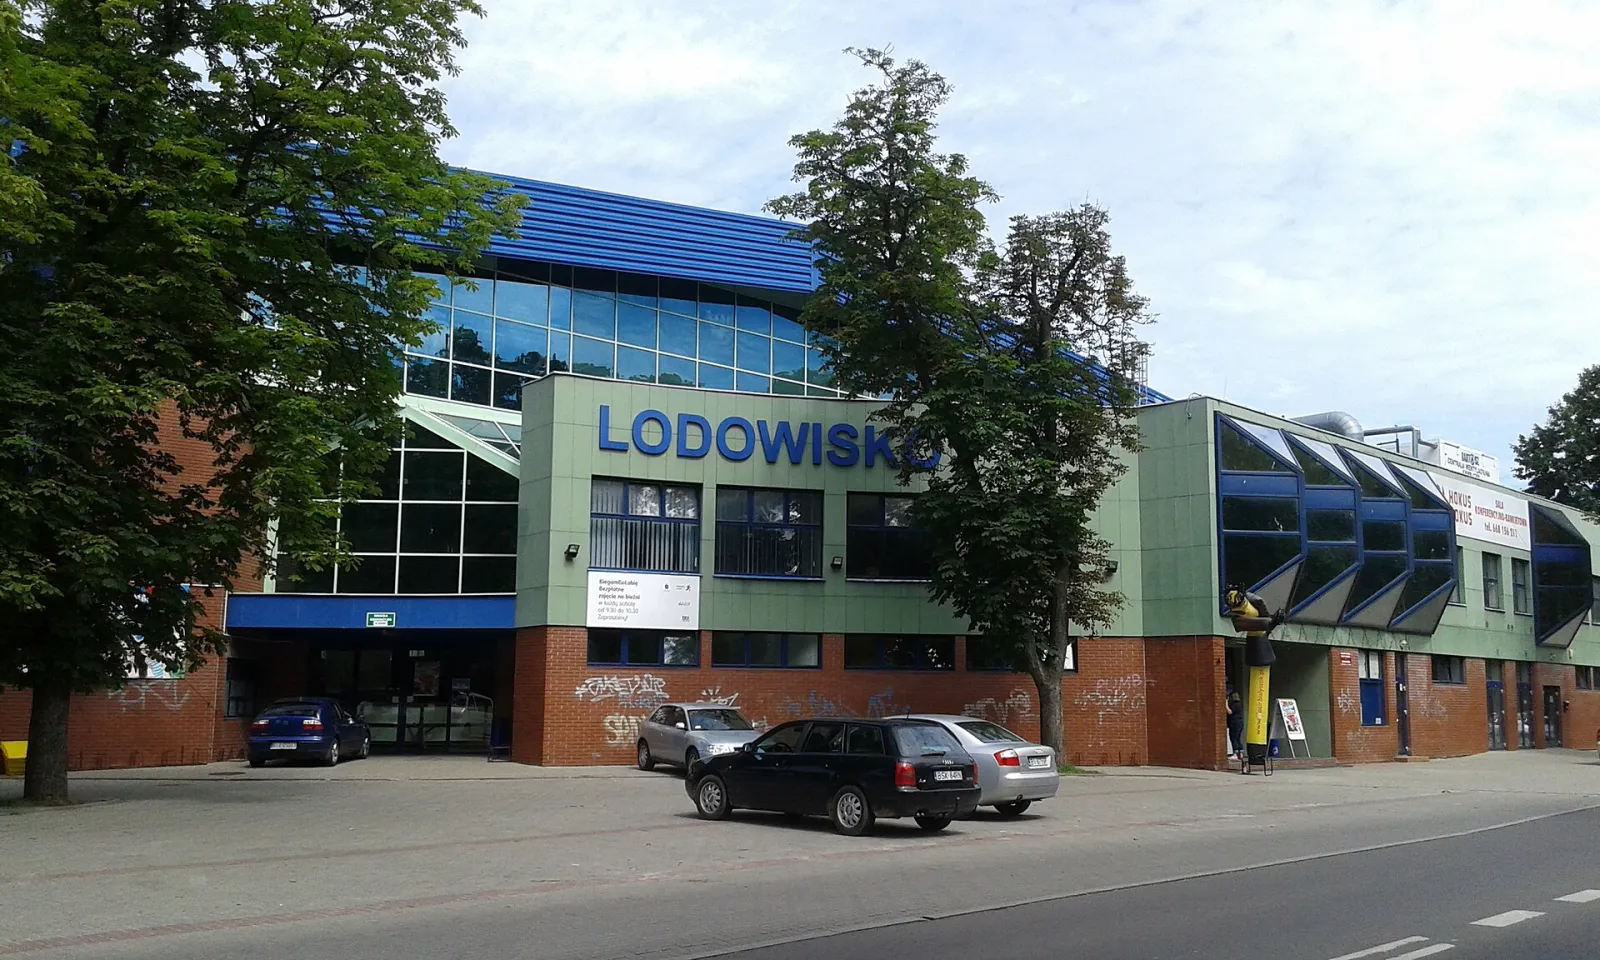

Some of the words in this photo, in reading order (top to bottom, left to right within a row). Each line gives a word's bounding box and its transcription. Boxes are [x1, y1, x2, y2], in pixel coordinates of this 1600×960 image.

[599, 405, 941, 470] LODOWISKO
[1448, 489, 1472, 509] HOKUS
[1454, 509, 1473, 526] OKUS
